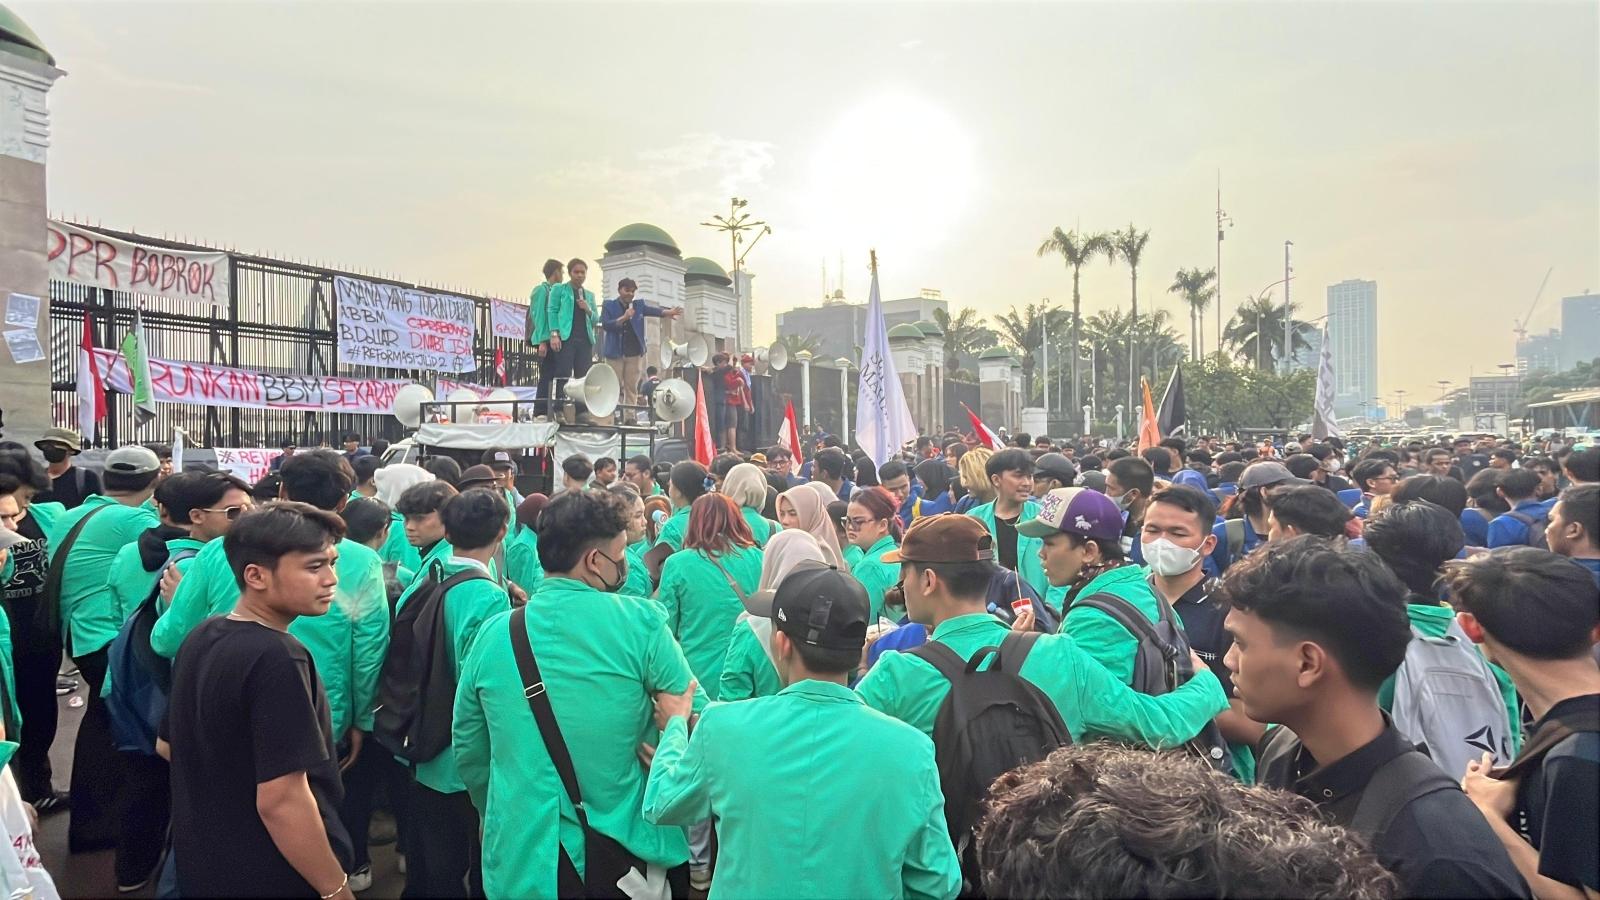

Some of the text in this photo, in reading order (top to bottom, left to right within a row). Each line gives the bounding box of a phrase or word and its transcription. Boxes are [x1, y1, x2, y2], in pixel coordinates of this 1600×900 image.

[130, 246, 216, 301] BOBROK
[337, 278, 384, 310] MANA
[383, 287, 413, 314] YANG
[261, 373, 324, 405] BBM
[323, 378, 411, 411] SEKARAN
